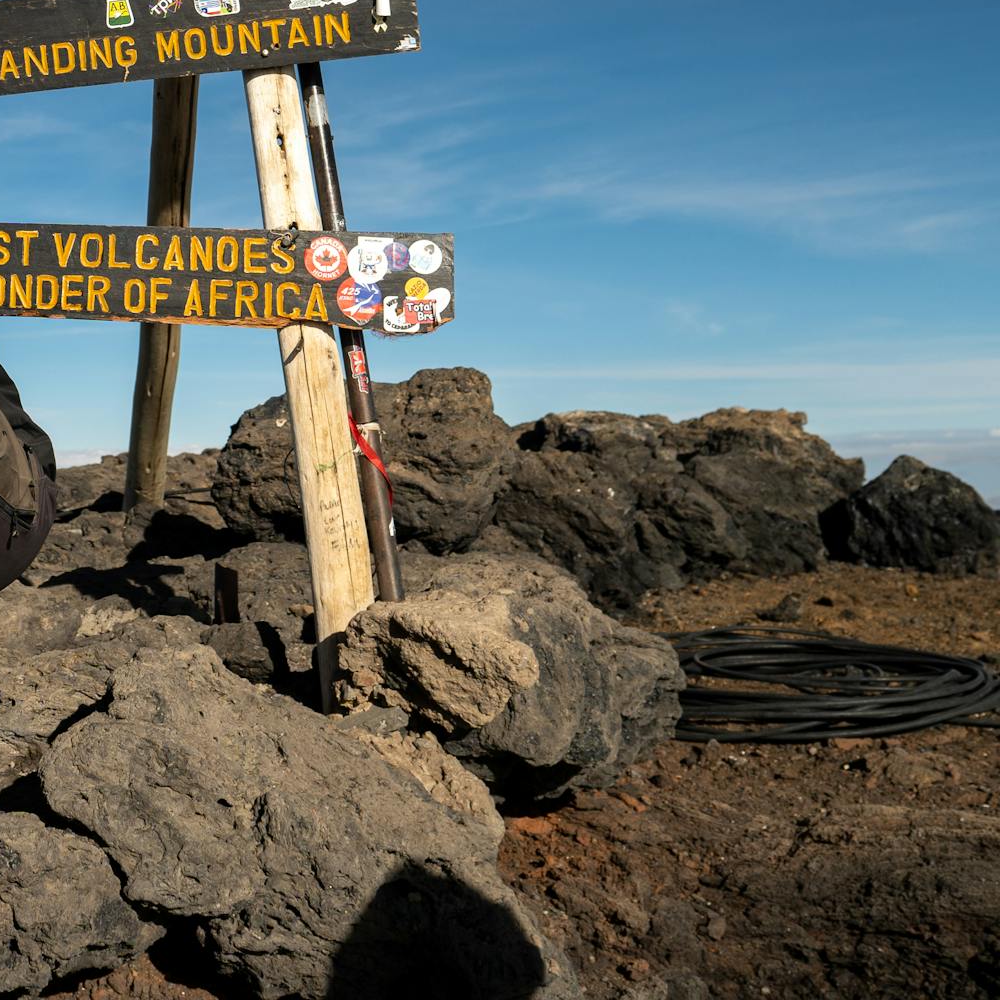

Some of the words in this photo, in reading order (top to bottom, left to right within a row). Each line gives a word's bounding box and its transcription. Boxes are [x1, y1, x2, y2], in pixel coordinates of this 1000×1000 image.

[155, 10, 351, 64] MOUNTAIN
[310, 238, 344, 252] CANADA
[52, 231, 296, 275] VOLCANOES
[123, 276, 173, 314] OF
[184, 278, 329, 321] AFRICA
[341, 287, 361, 296] 425
[406, 301, 432, 312] Total
[417, 312, 434, 321] Bre
